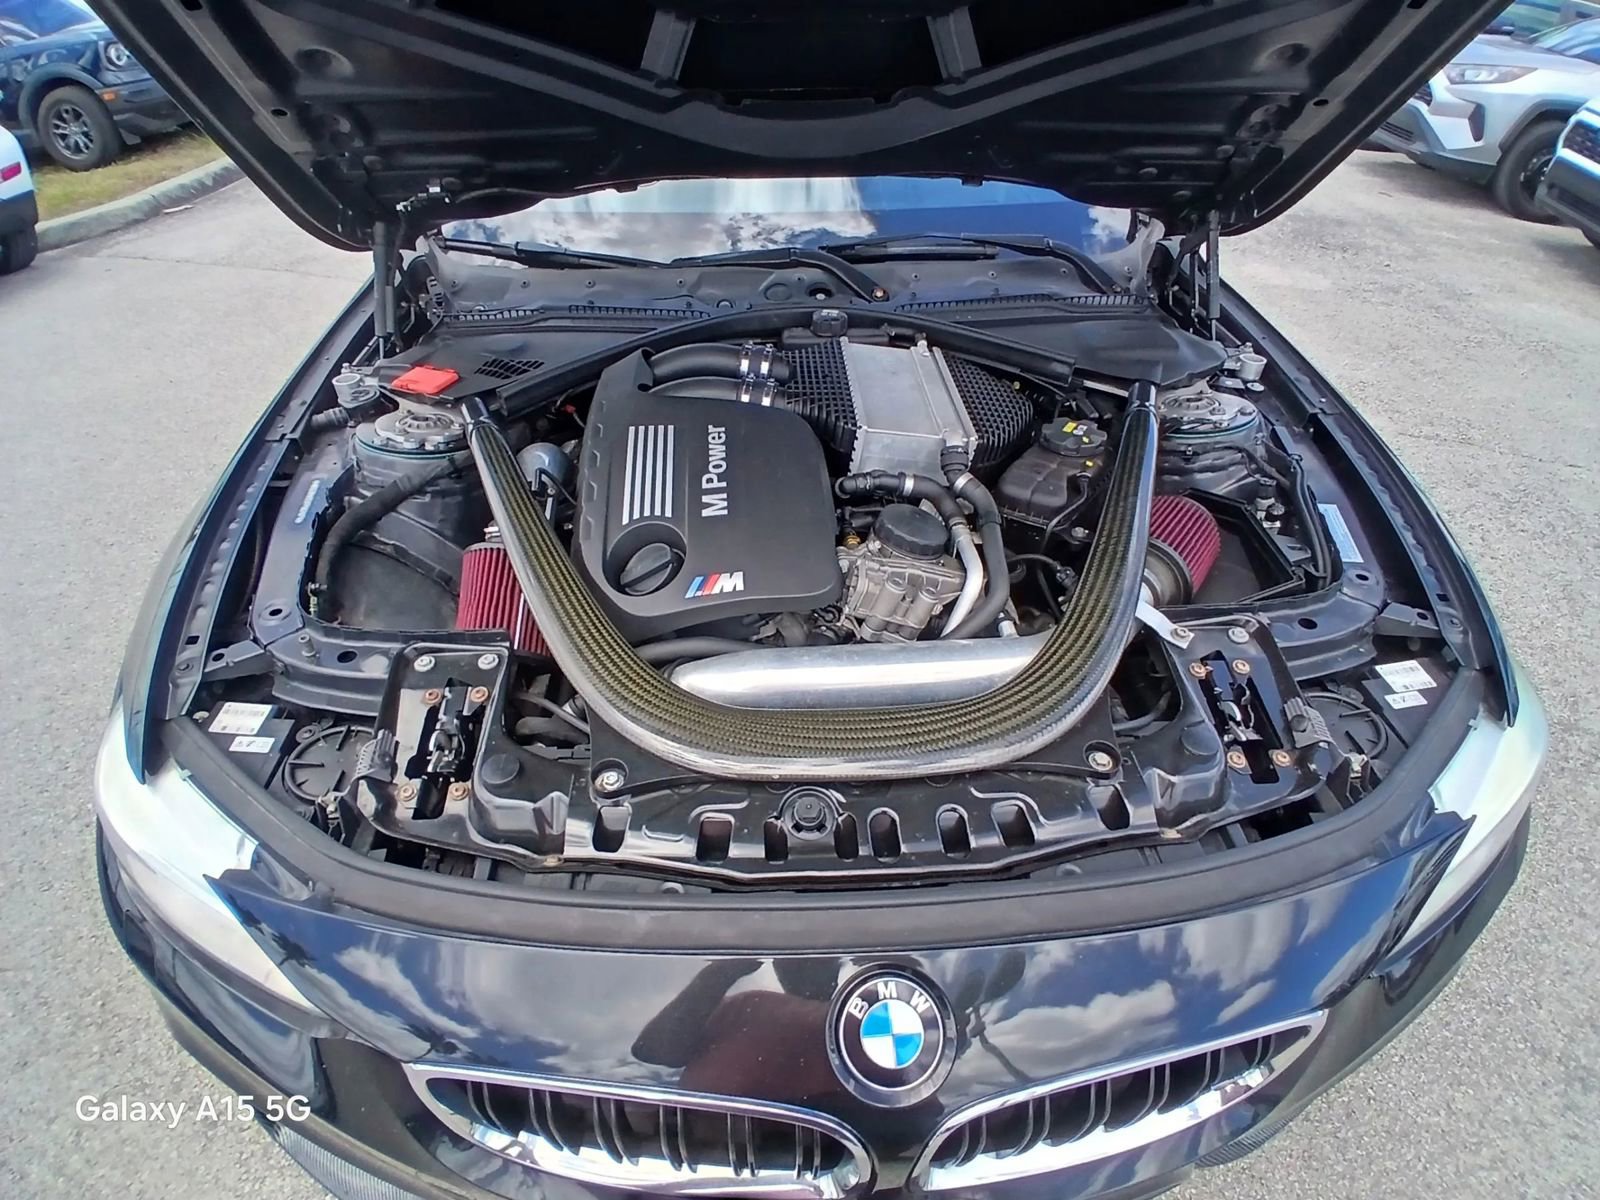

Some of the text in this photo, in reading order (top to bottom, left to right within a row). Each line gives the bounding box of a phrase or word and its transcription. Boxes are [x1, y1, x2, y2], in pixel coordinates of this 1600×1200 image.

[701, 424, 729, 518] M Power
[848, 981, 931, 1020] BMW
